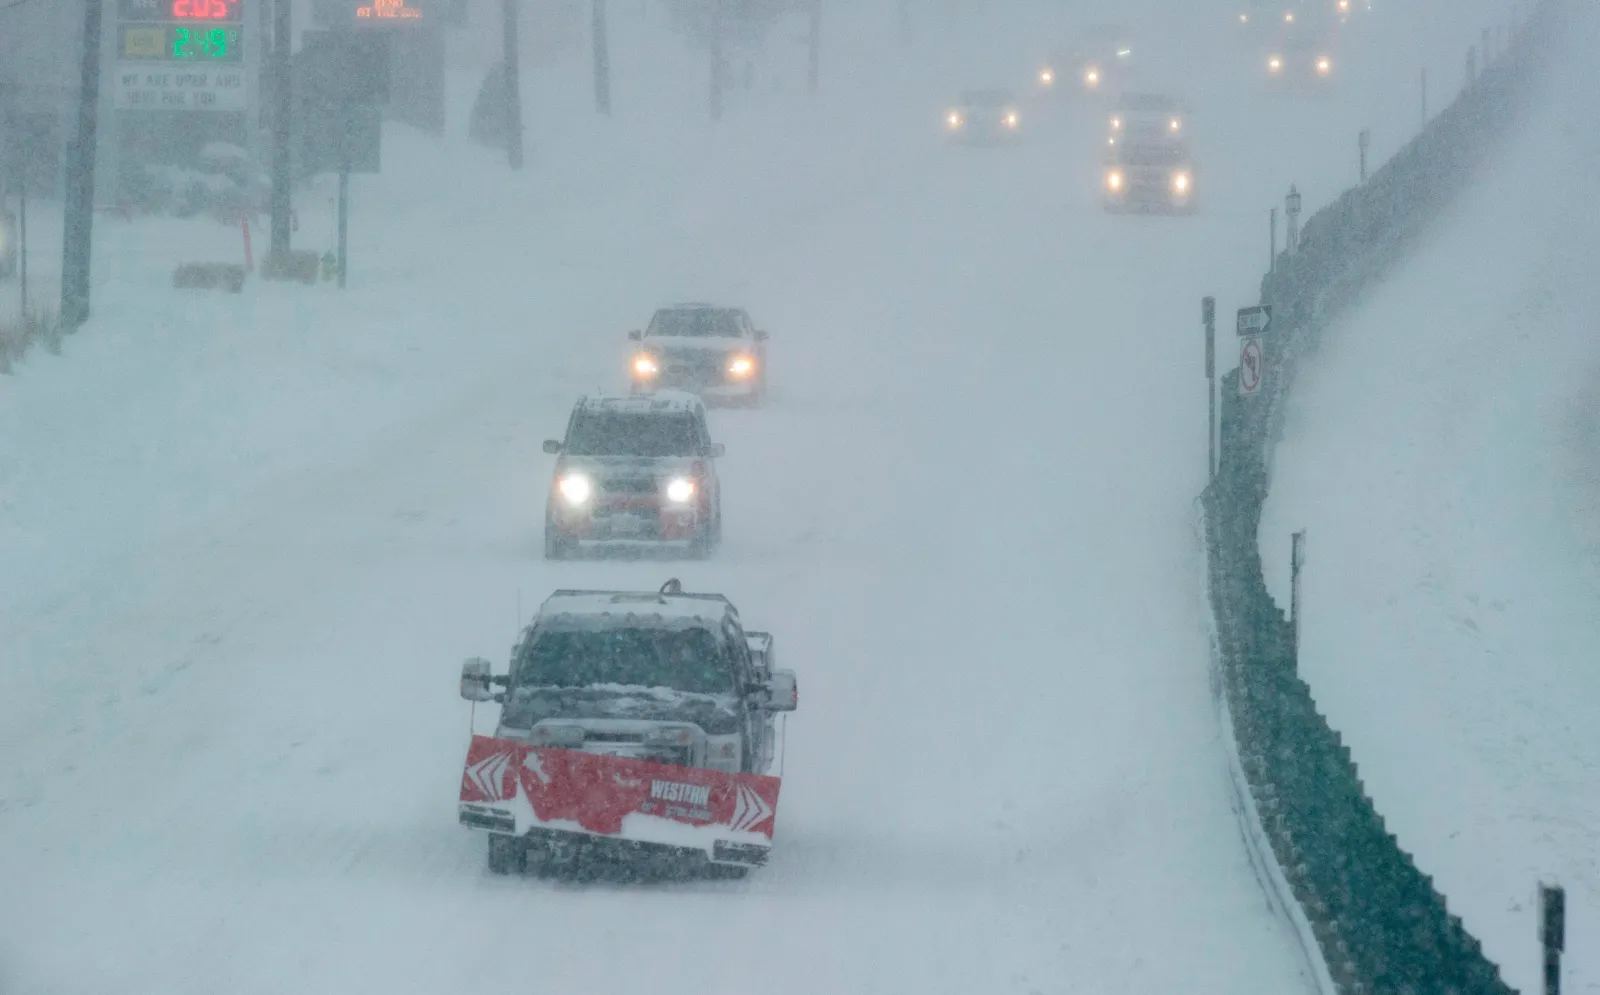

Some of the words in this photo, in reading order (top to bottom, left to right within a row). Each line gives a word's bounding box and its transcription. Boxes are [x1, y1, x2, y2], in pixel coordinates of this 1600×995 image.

[174, 0, 227, 17] 2.05
[174, 28, 227, 56] 2.49
[146, 74, 170, 86] ARE
[651, 779, 711, 806] WESTERN
